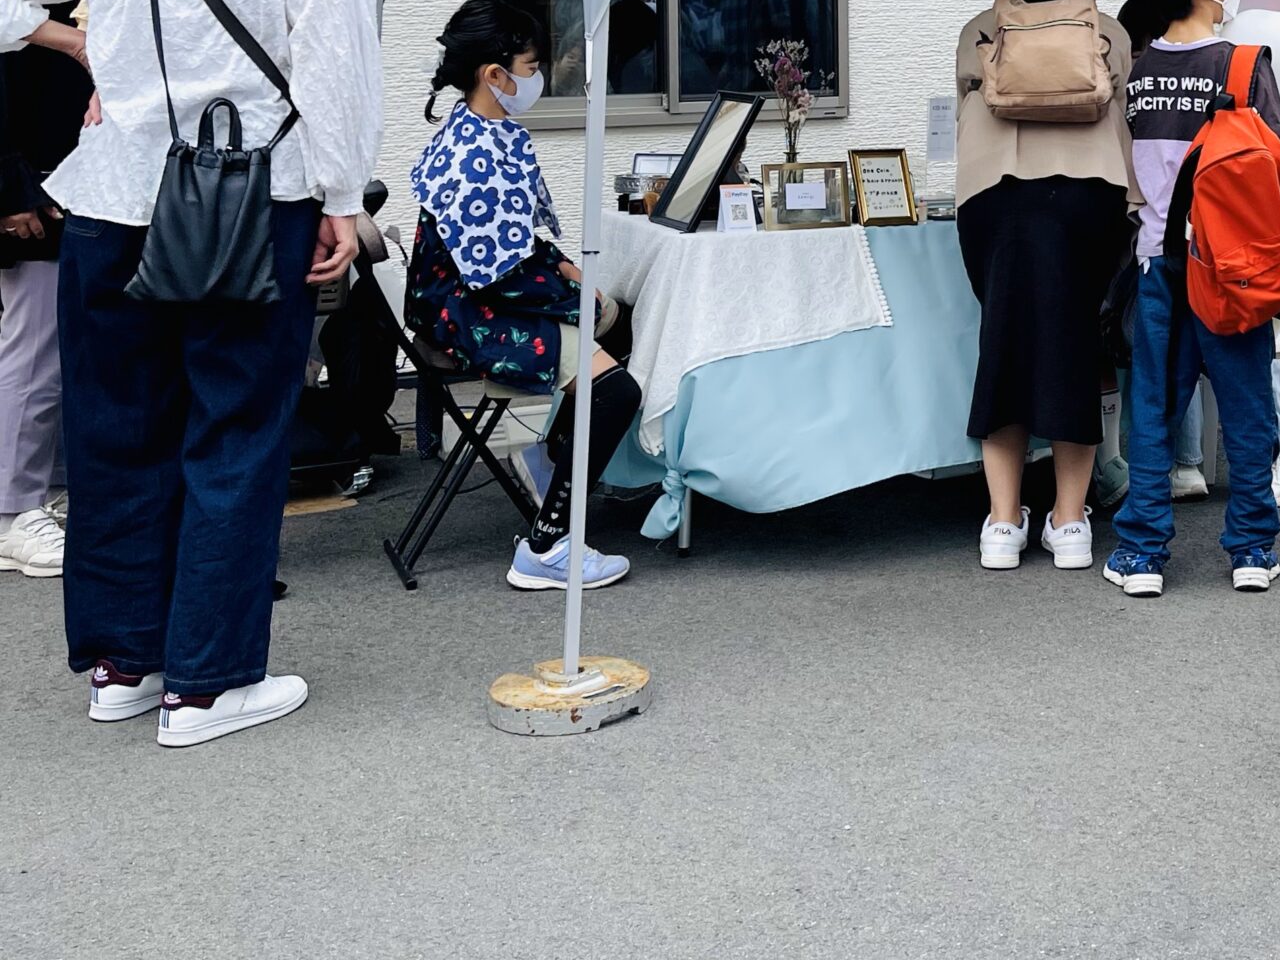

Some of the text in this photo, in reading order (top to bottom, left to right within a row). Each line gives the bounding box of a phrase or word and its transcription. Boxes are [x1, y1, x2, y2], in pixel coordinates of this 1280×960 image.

[1126, 76, 1154, 95] TRUE
[1157, 77, 1178, 90] TO
[1181, 77, 1213, 92] WHO
[1176, 97, 1192, 111] IS
[994, 527, 1011, 535] FILA
[1064, 527, 1081, 535] FILA
